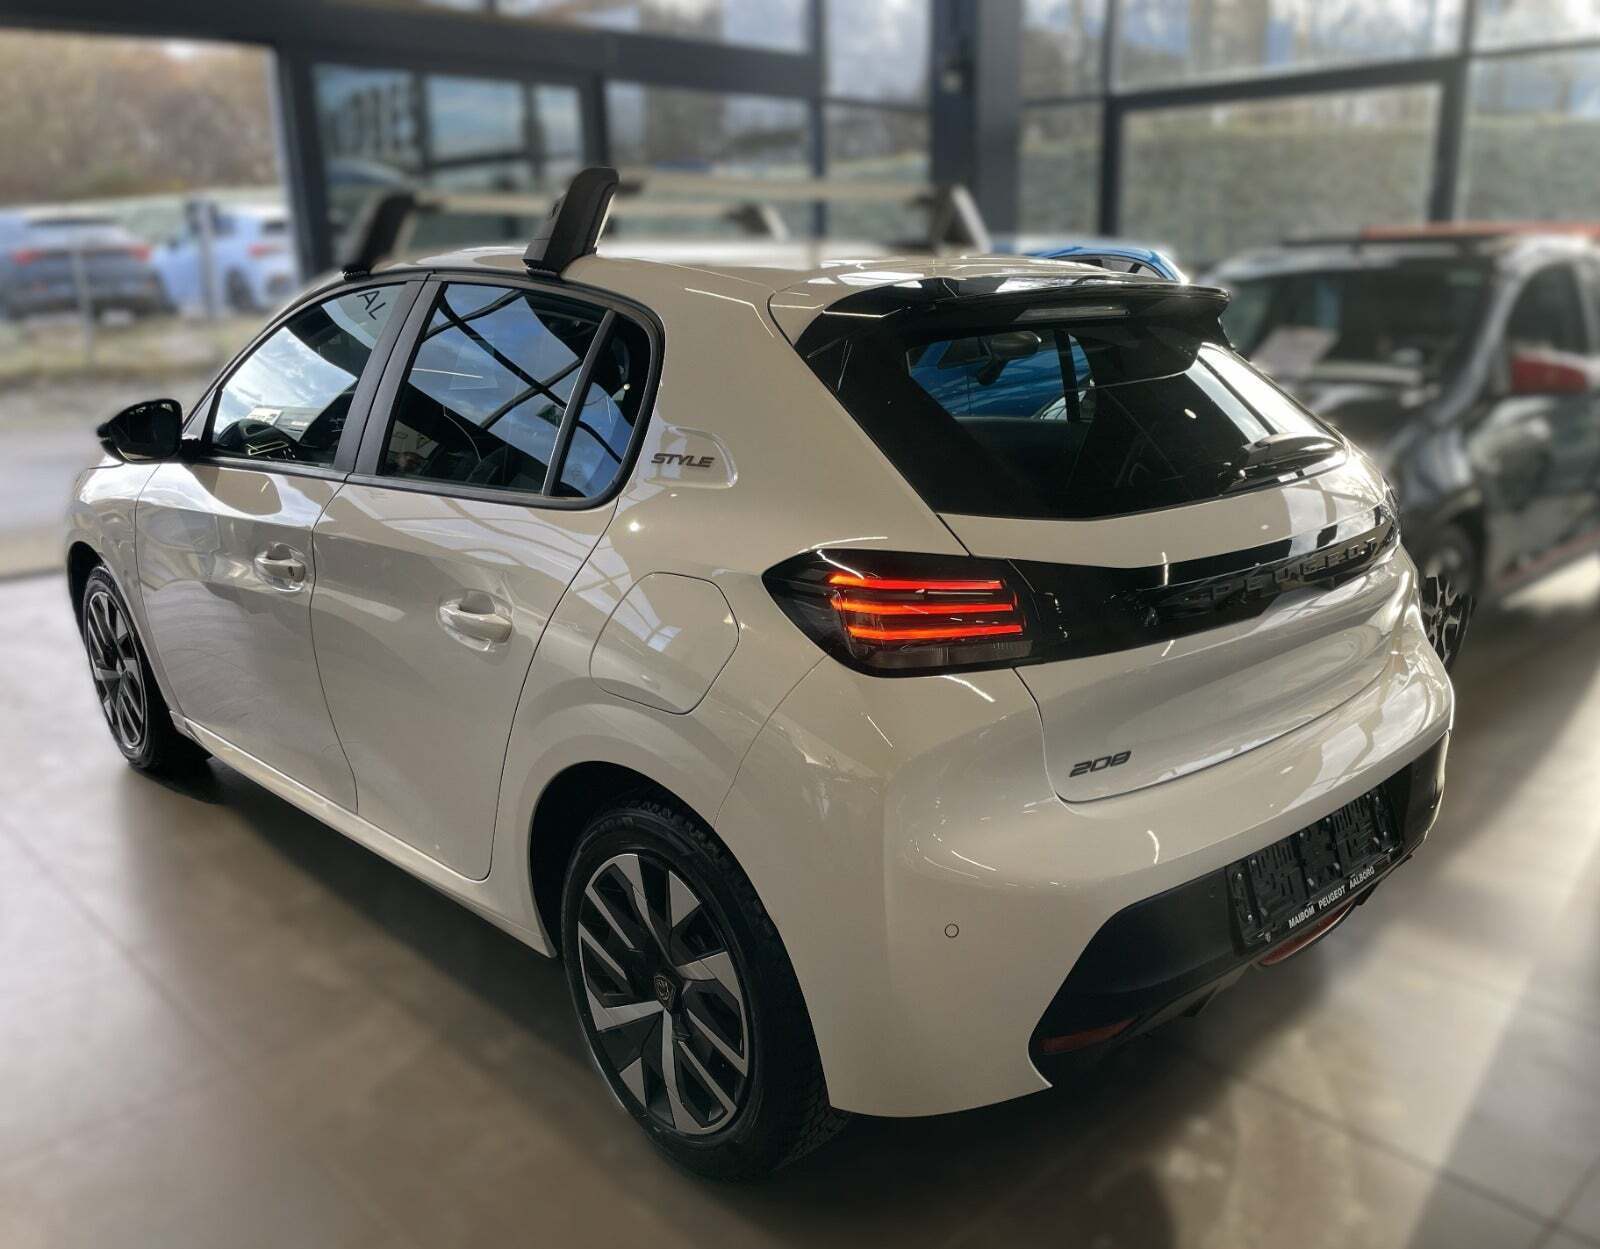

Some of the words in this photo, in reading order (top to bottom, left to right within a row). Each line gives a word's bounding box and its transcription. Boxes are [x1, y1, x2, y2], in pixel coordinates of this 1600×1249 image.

[651, 452, 715, 468] STYLE
[1069, 750, 1132, 778] 208
[1288, 903, 1315, 928] MAIBOM
[1318, 885, 1346, 910] PEUGEOT
[1349, 865, 1375, 889] AALBORG
